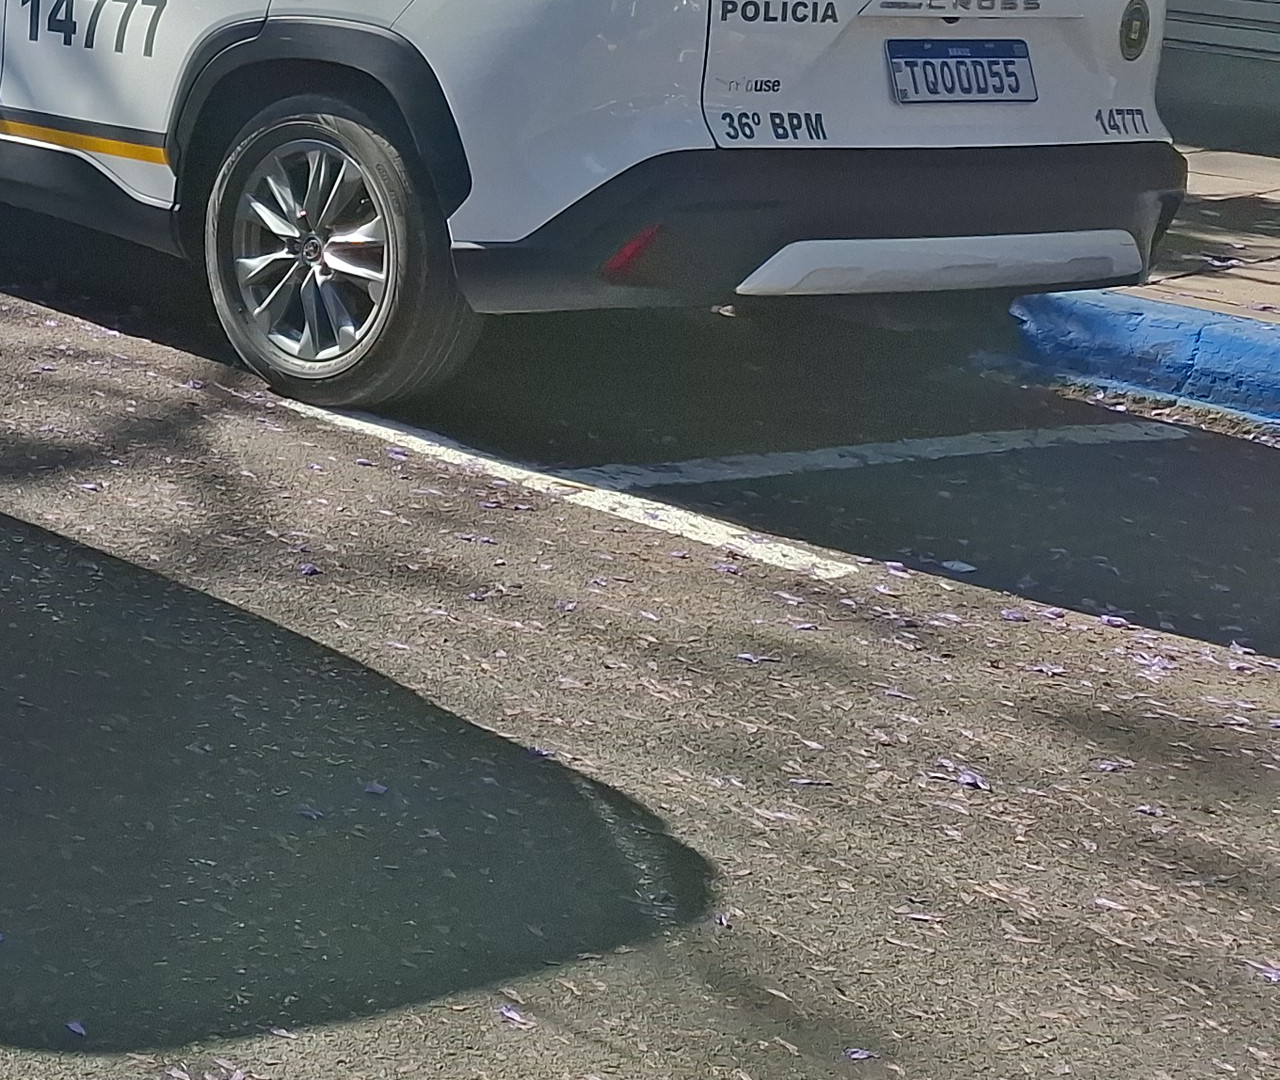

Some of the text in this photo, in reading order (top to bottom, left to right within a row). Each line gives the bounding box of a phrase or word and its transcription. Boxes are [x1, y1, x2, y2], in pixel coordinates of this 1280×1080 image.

[721, 112, 828, 140] 36º BPM
[1095, 108, 1150, 135] 14777
